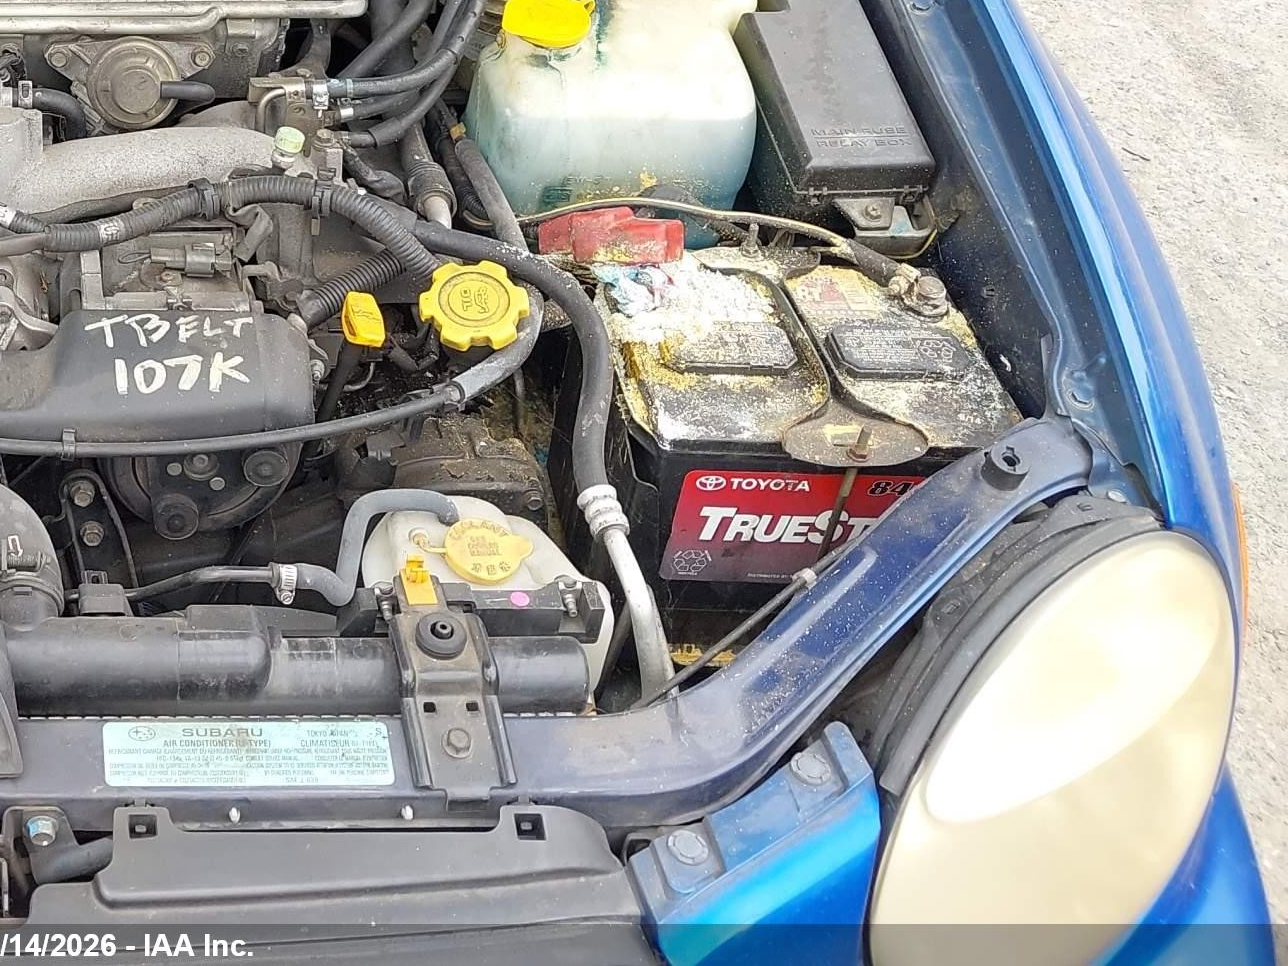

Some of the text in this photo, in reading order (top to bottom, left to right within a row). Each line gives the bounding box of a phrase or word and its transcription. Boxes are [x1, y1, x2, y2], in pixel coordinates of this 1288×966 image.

[811, 125, 907, 136] MAIN FUSE
[816, 137, 912, 148] RELAY BOX
[461, 288, 472, 312] OIL
[114, 351, 251, 395] 107K
[730, 477, 810, 492] TOYOTA
[182, 727, 263, 737] SUBARU
[163, 739, 178, 748] AIR
[179, 739, 234, 748] CONDITIONER
